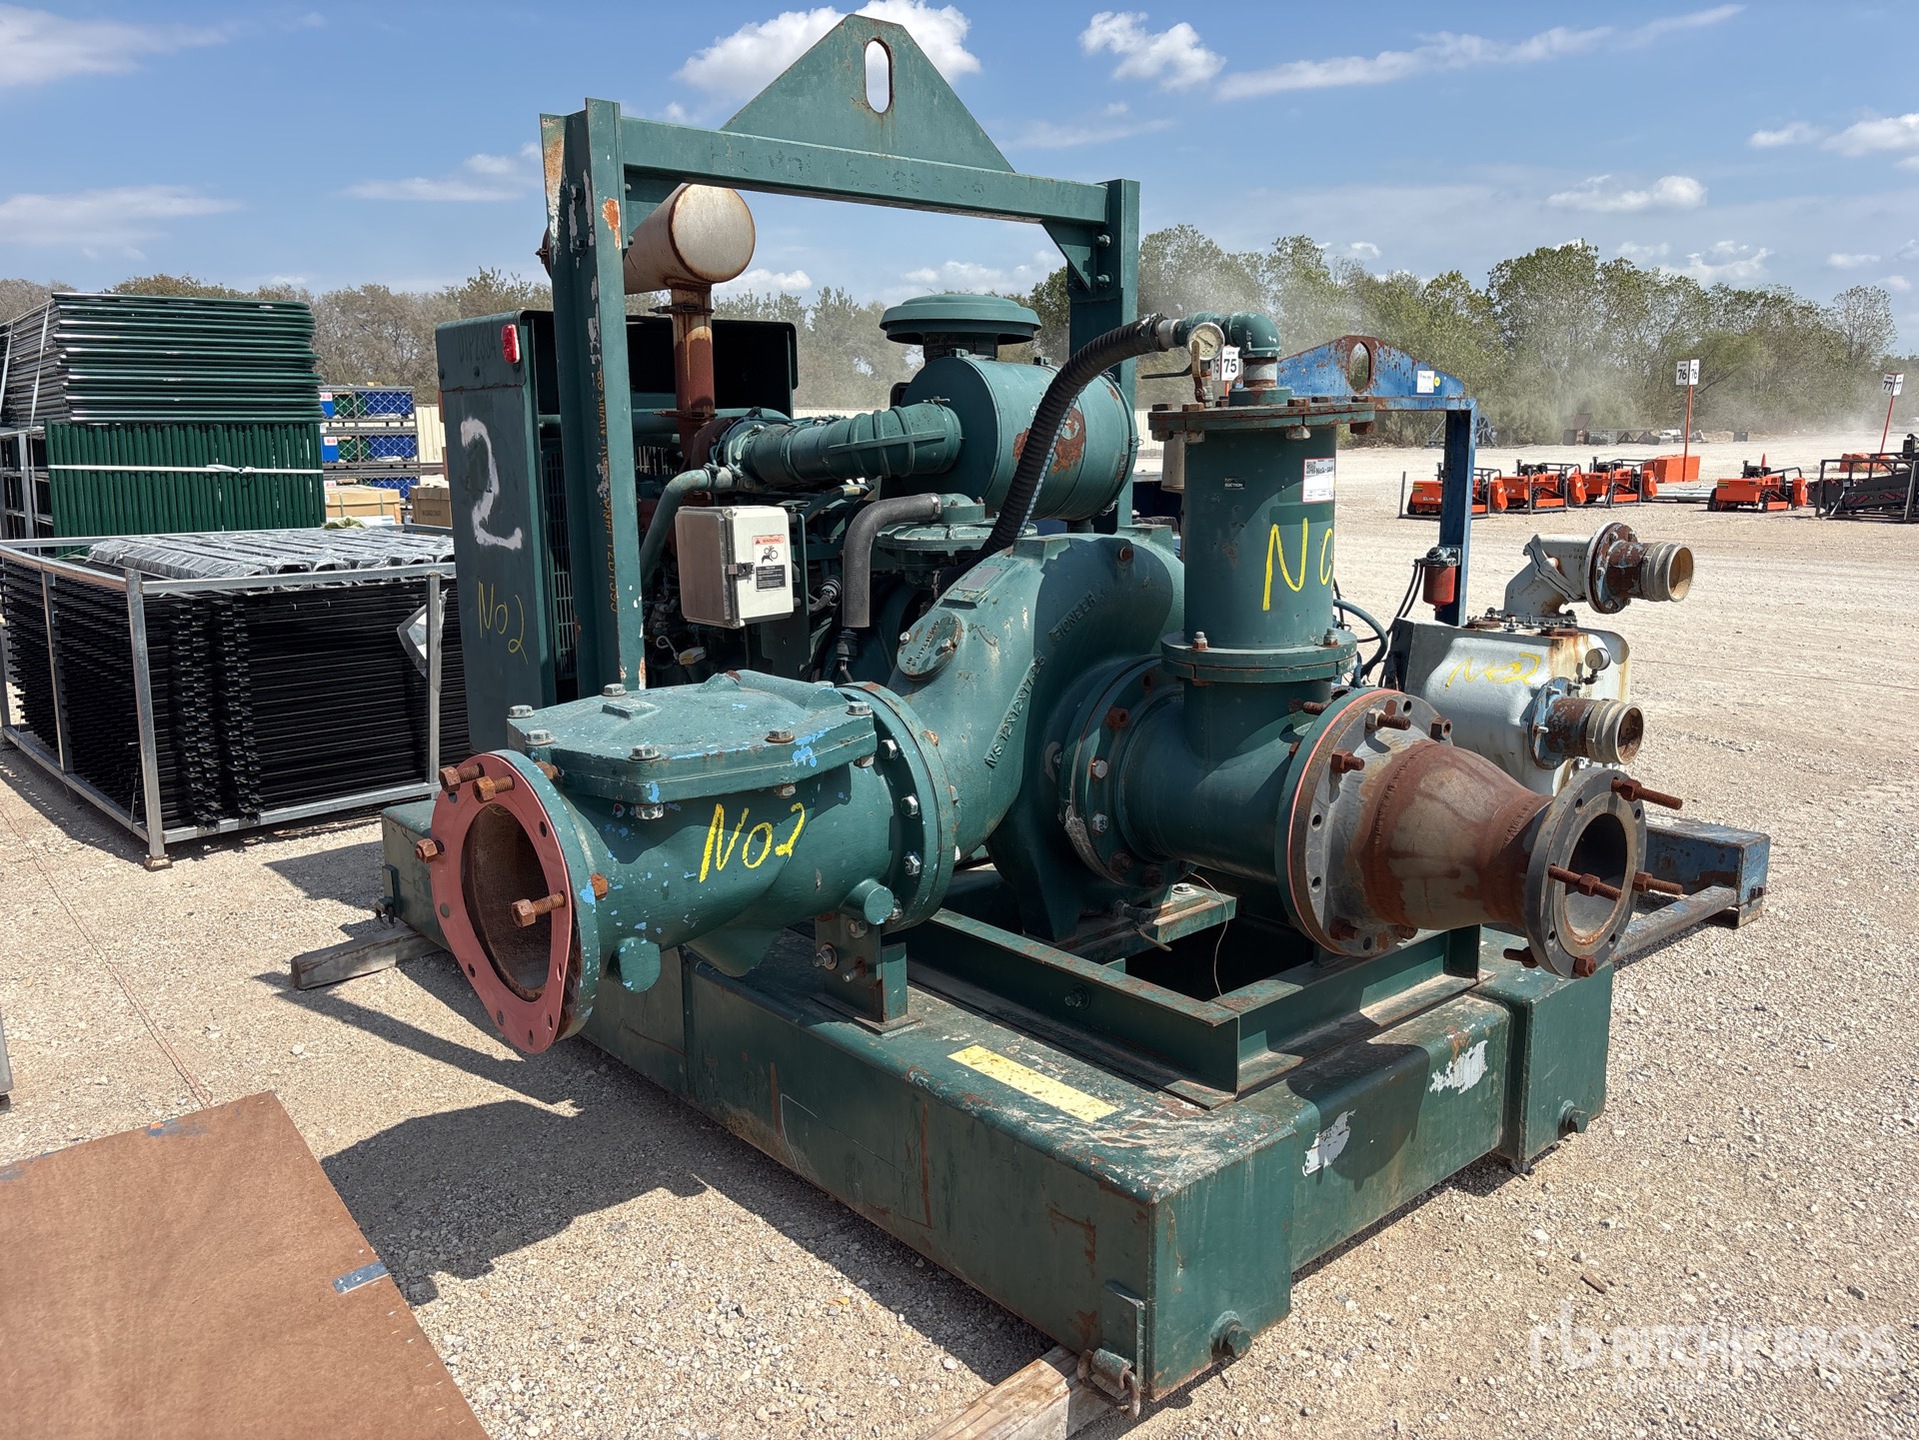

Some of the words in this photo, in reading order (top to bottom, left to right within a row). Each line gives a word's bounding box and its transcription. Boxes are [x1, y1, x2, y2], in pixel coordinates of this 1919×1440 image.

[1223, 358, 1237, 373] 75
[1677, 368, 1687, 380] 76
[1690, 368, 1698, 380] 76
[1883, 380, 1893, 391] 77
[461, 416, 523, 550] 2
